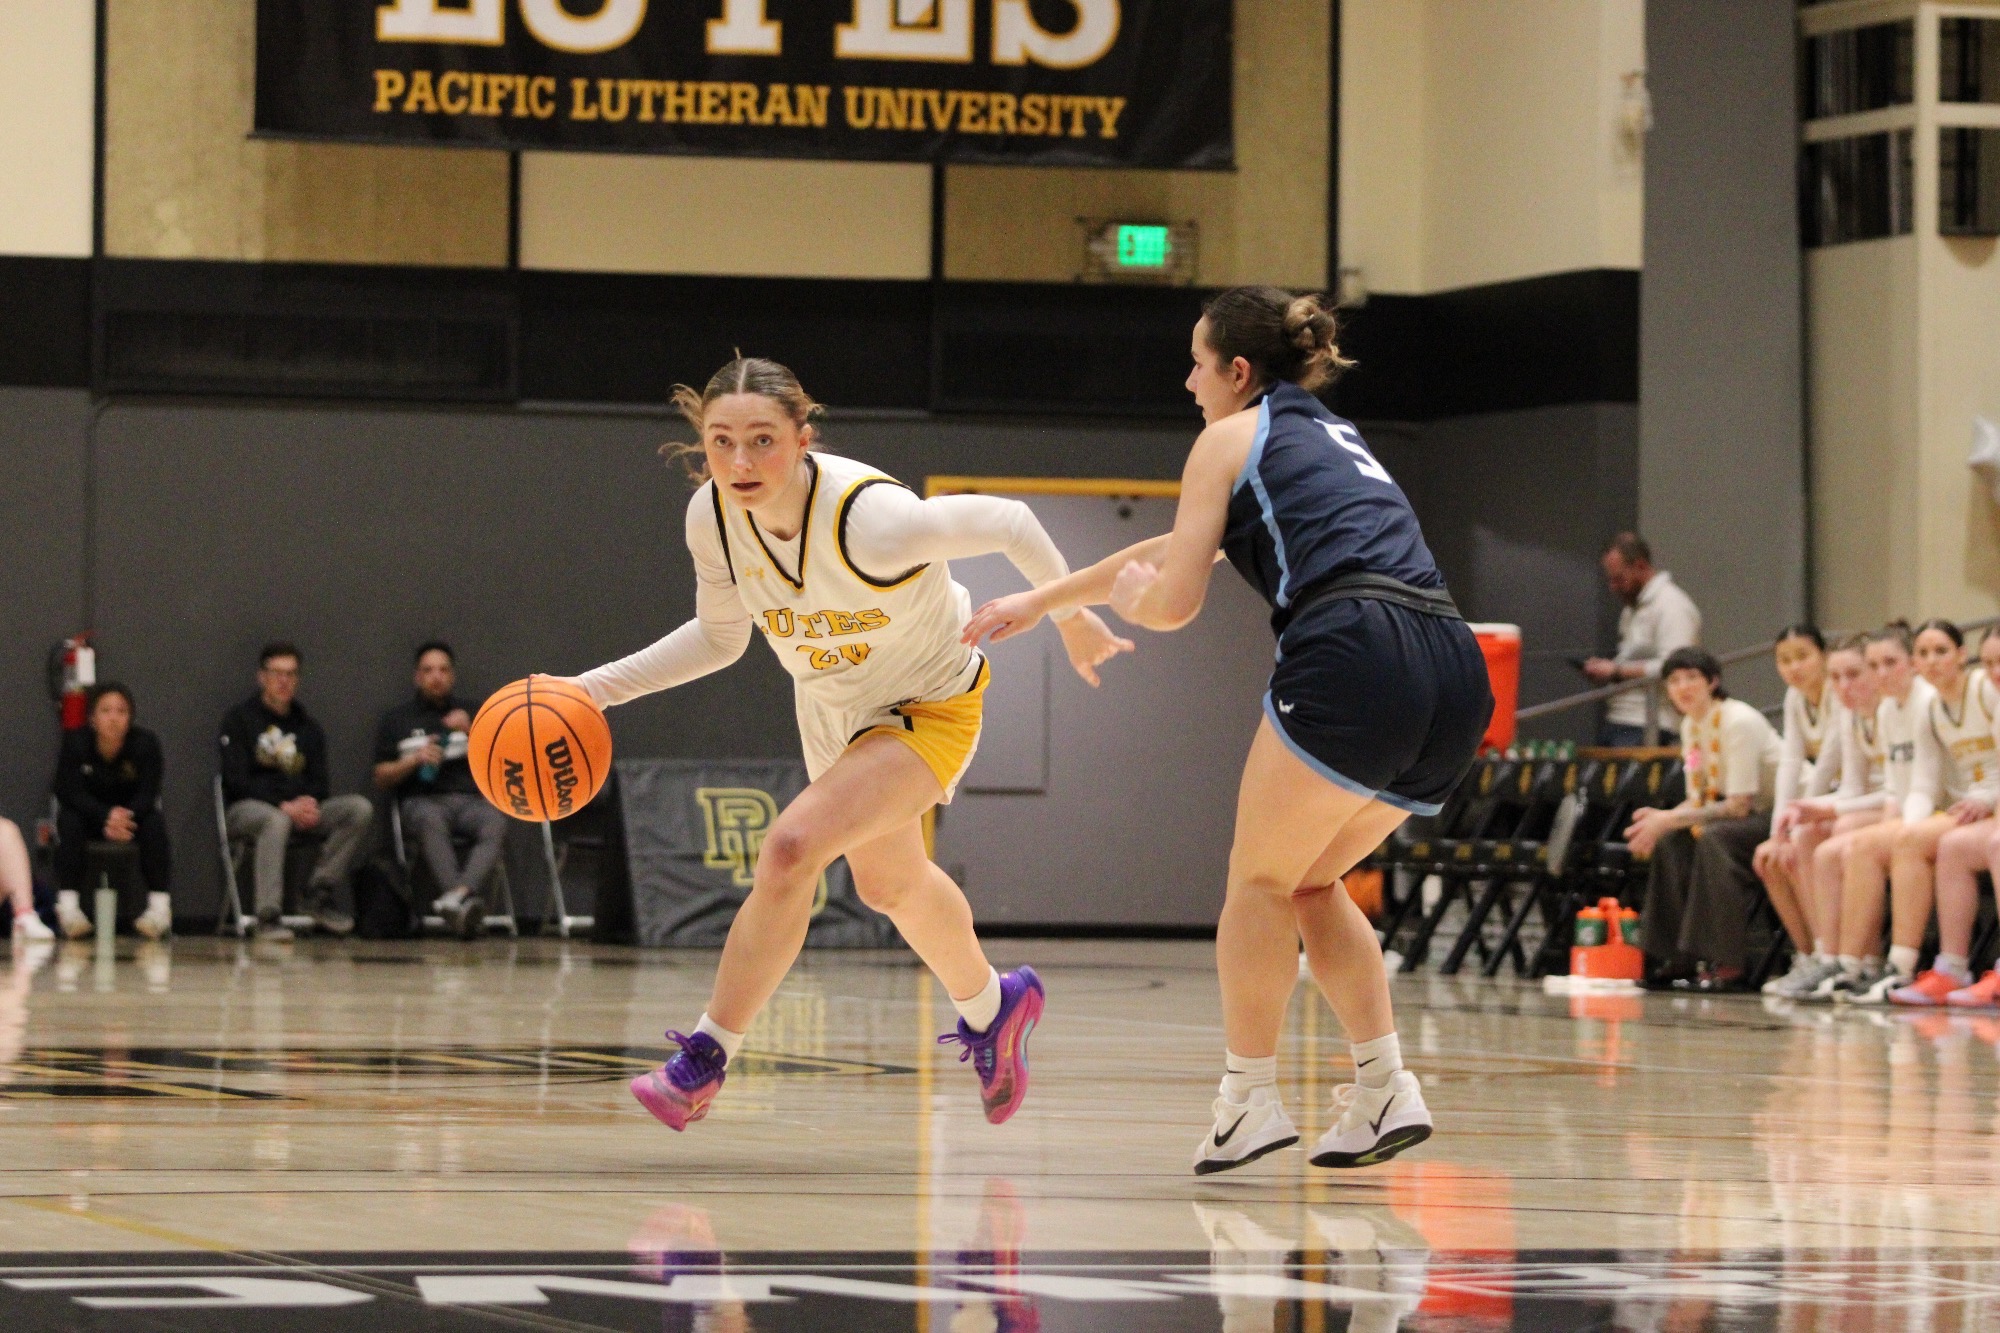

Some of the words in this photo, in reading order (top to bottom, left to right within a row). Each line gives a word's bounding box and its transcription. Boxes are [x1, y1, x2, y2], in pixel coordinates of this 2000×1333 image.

[372, 68, 557, 120] PACIFIC
[570, 77, 831, 127] LUTHERAN
[843, 86, 1127, 139] UNIVERSITY
[1313, 417, 1393, 485] 5
[761, 607, 892, 639] UTES
